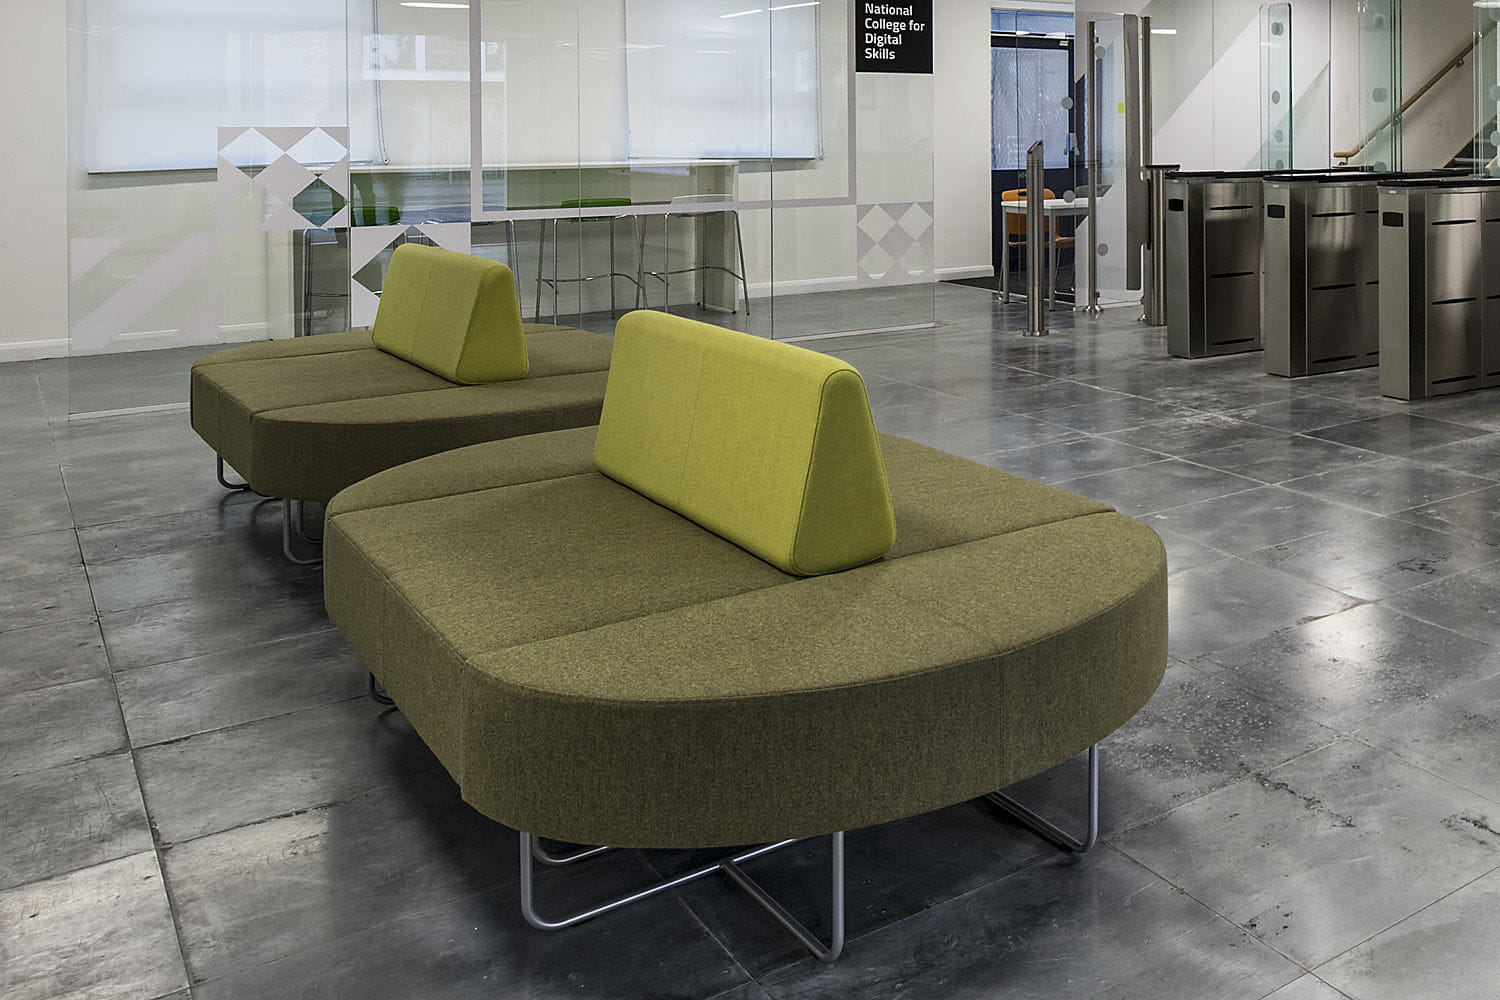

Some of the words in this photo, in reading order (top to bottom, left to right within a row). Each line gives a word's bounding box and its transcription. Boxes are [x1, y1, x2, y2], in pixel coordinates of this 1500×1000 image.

[865, 3, 913, 16] National
[865, 18, 906, 33] College
[909, 20, 925, 32] for
[865, 33, 902, 47] Digital
[865, 47, 896, 60] Skills
